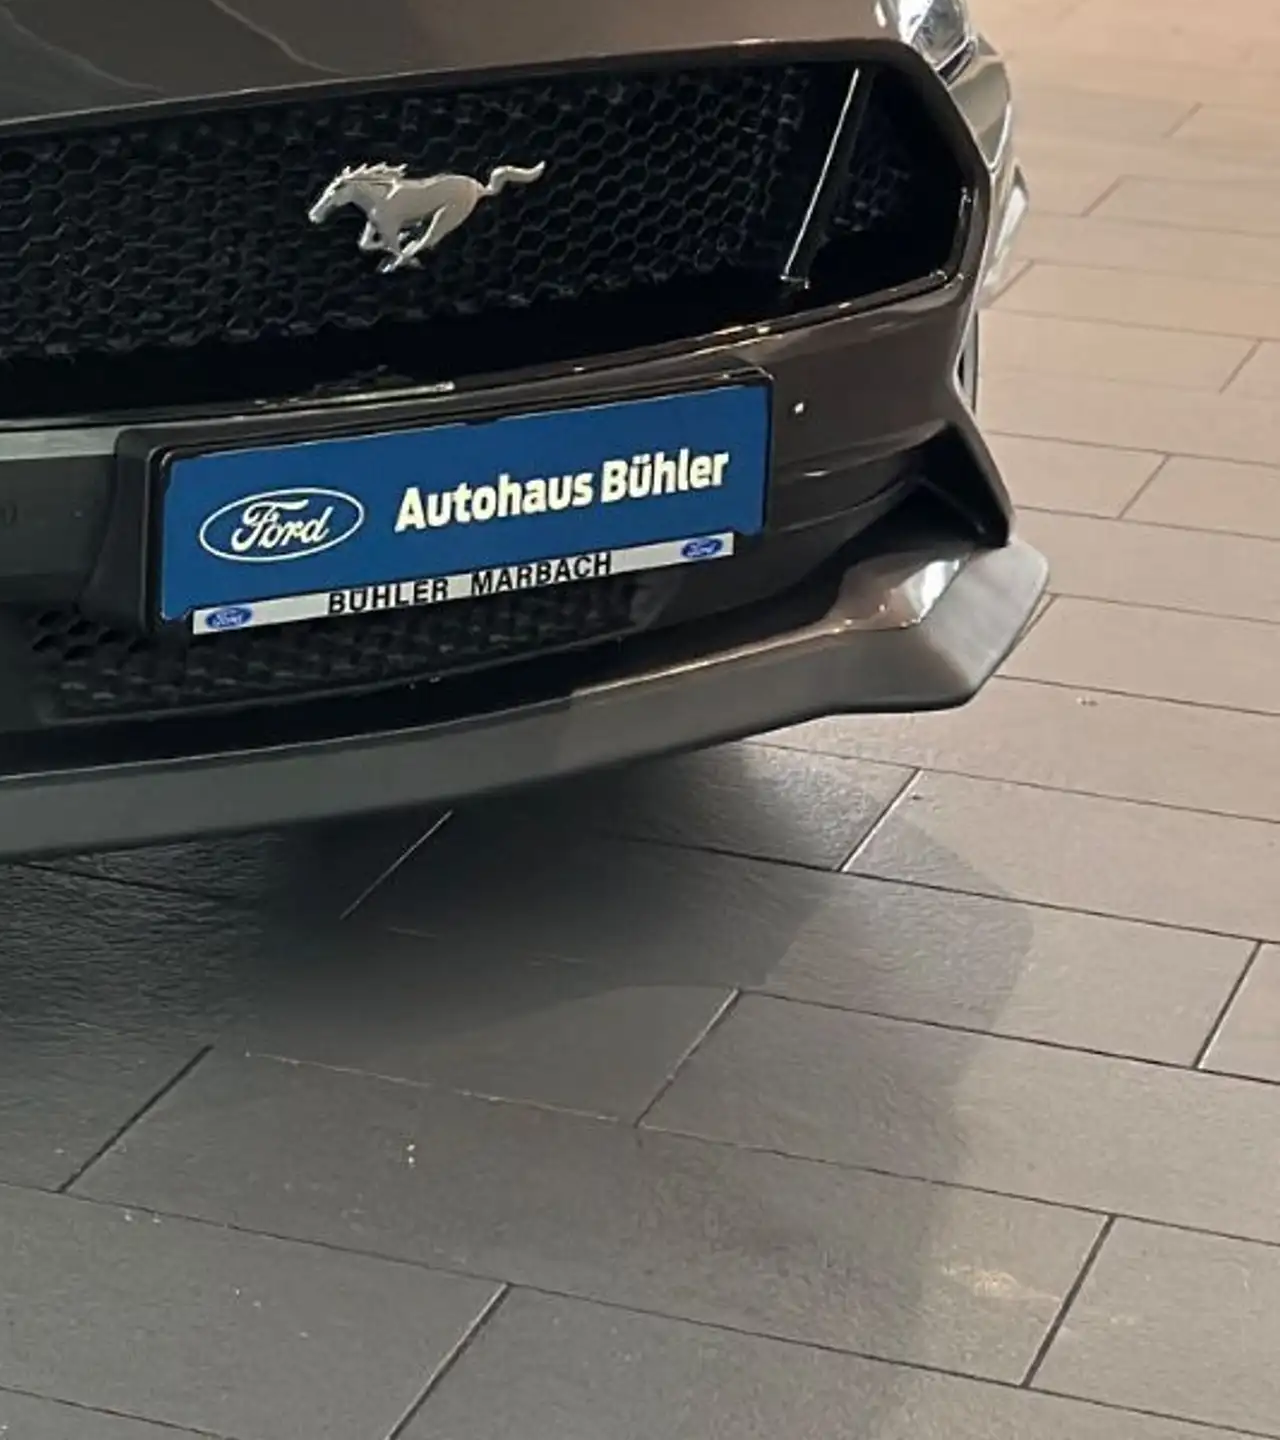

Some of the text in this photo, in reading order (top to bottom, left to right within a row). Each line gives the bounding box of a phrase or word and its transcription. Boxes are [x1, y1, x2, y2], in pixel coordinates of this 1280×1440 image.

[395, 448, 729, 533] Autohaus Bühler
[228, 496, 337, 555] Ford
[471, 550, 612, 596] MARBACH
